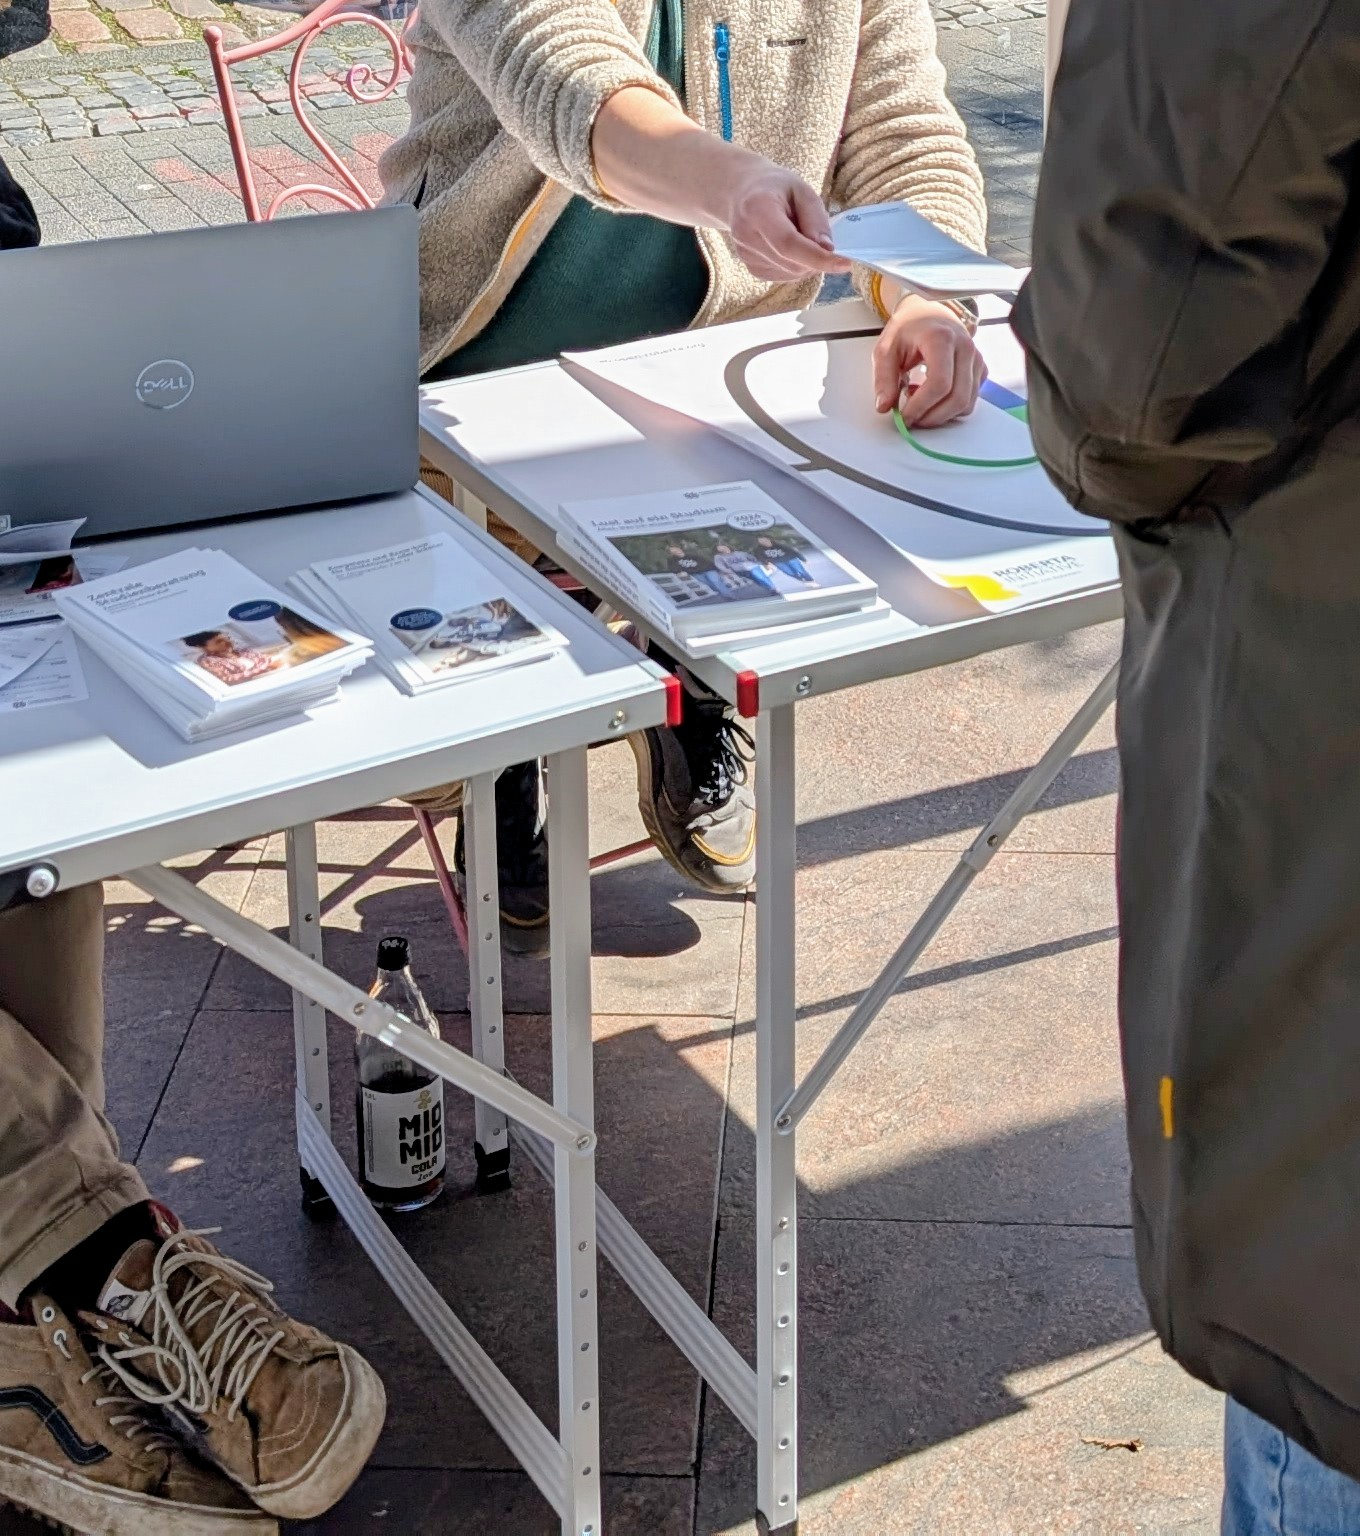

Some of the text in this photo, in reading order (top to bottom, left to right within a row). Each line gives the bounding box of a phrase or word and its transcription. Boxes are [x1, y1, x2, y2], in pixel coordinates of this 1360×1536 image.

[144, 376, 188, 393] DELL
[399, 1100, 441, 1140] MIO
[400, 1124, 442, 1165] MIO
[411, 1155, 438, 1175] COLA
